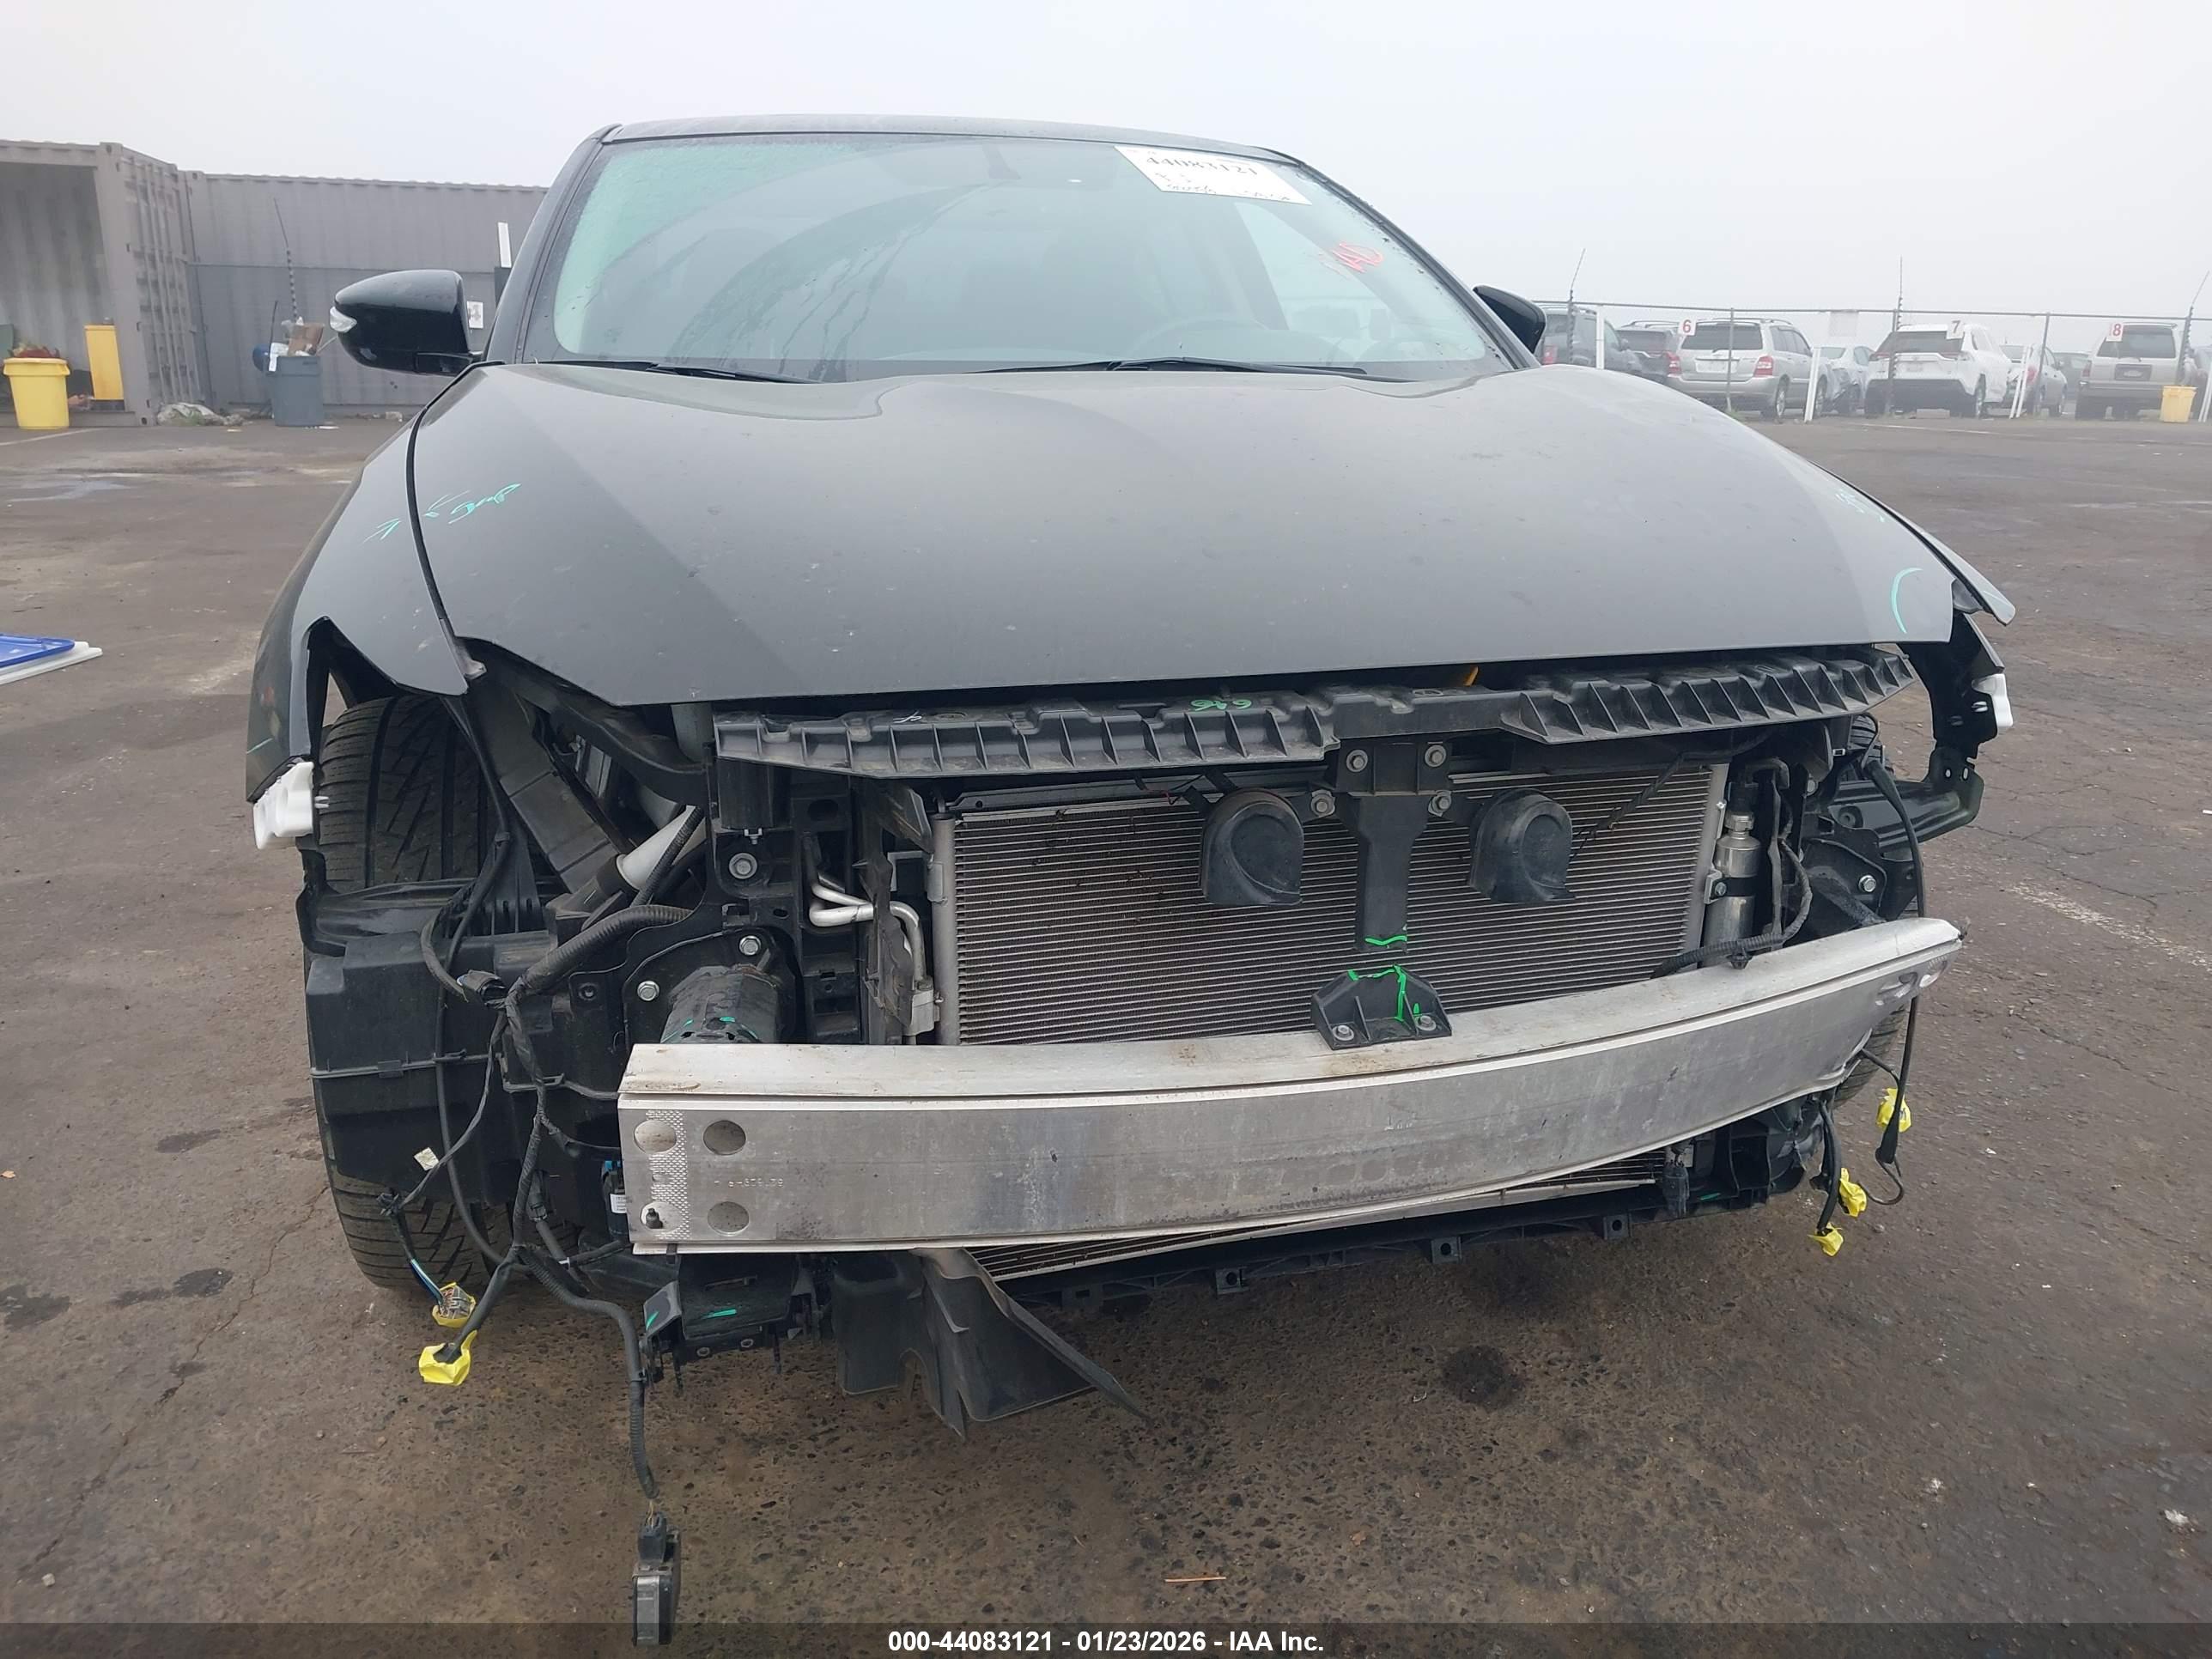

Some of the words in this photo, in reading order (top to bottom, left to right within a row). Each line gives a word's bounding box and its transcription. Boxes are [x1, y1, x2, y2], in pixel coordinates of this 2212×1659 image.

[1682, 319, 1692, 333] 6
[1951, 319, 1961, 334] 7
[2112, 323, 2122, 337] 8
